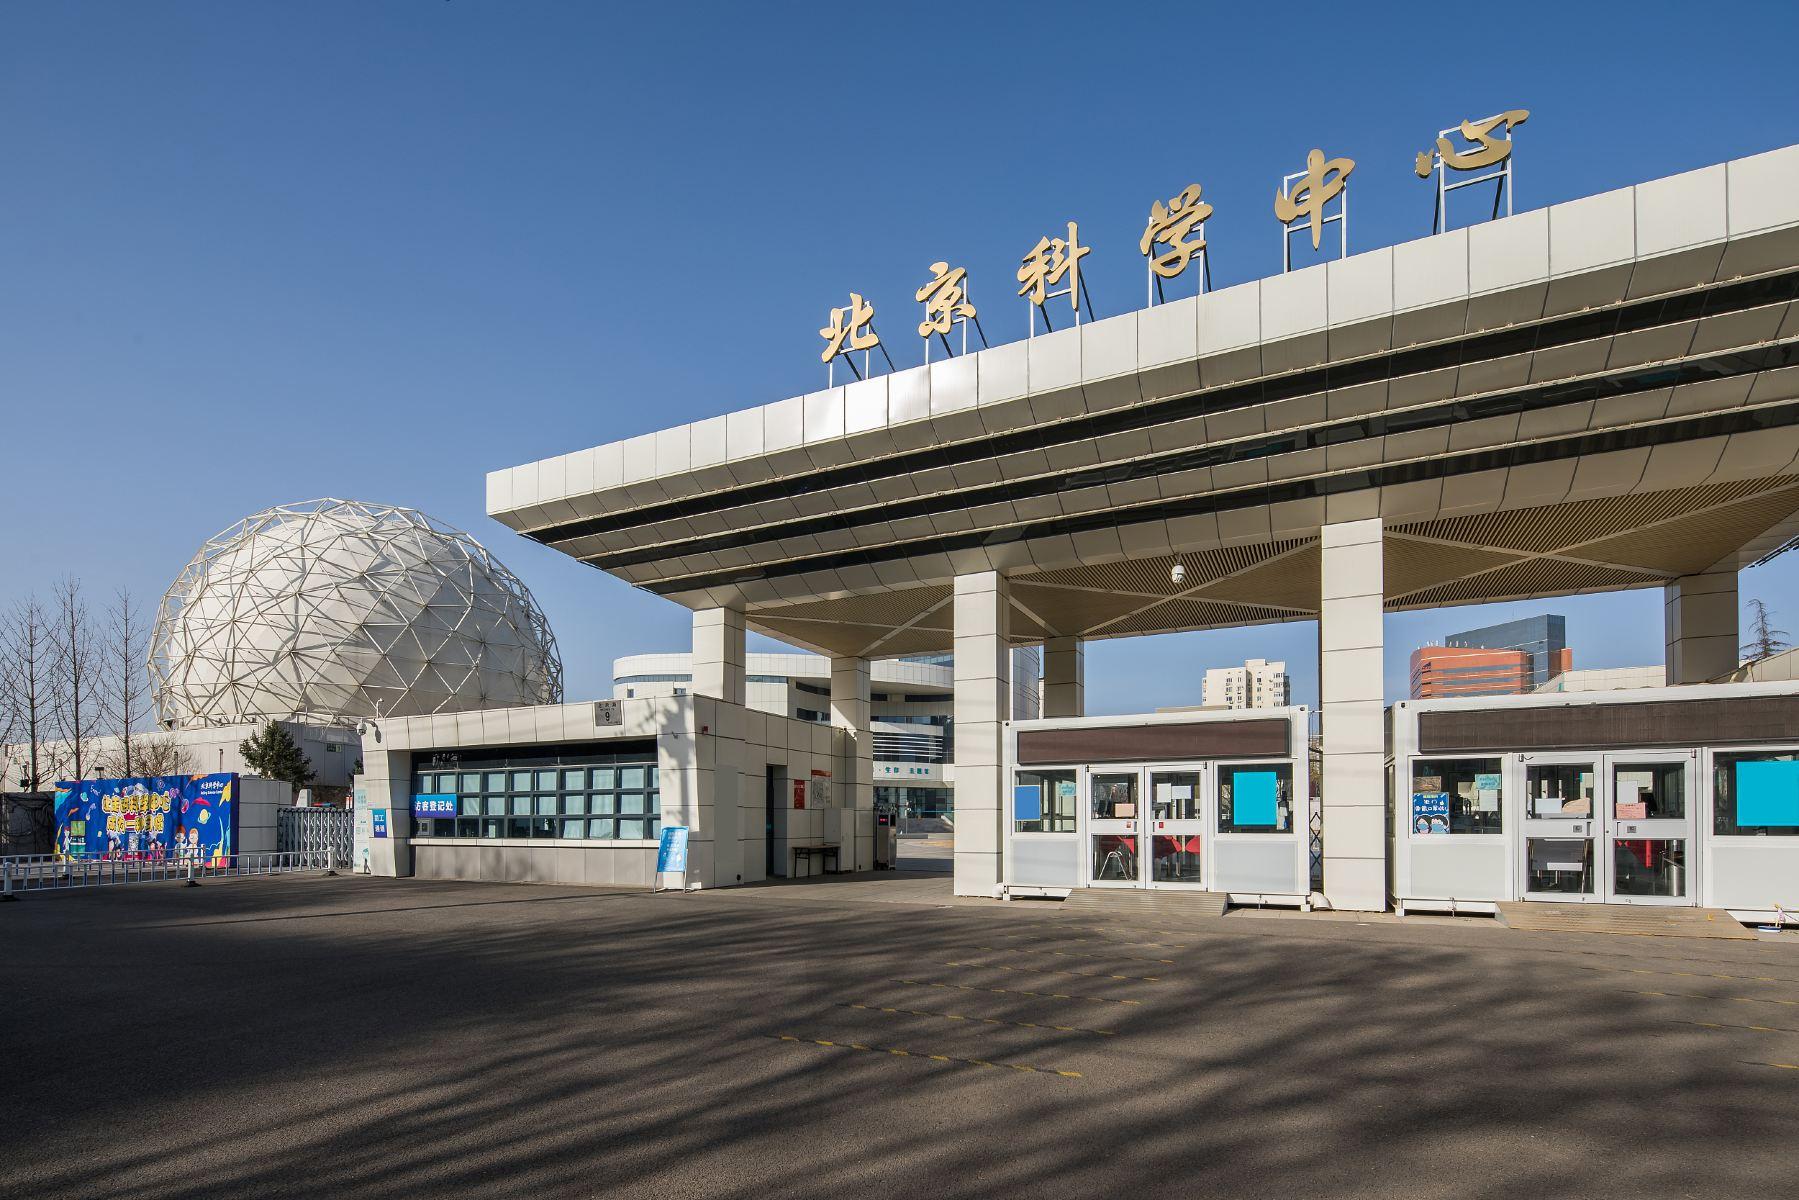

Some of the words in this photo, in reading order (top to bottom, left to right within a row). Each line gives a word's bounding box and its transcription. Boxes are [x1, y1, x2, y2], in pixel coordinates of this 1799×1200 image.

[820, 109, 1530, 363] 北京科学中心
[605, 711, 610, 721] 9
